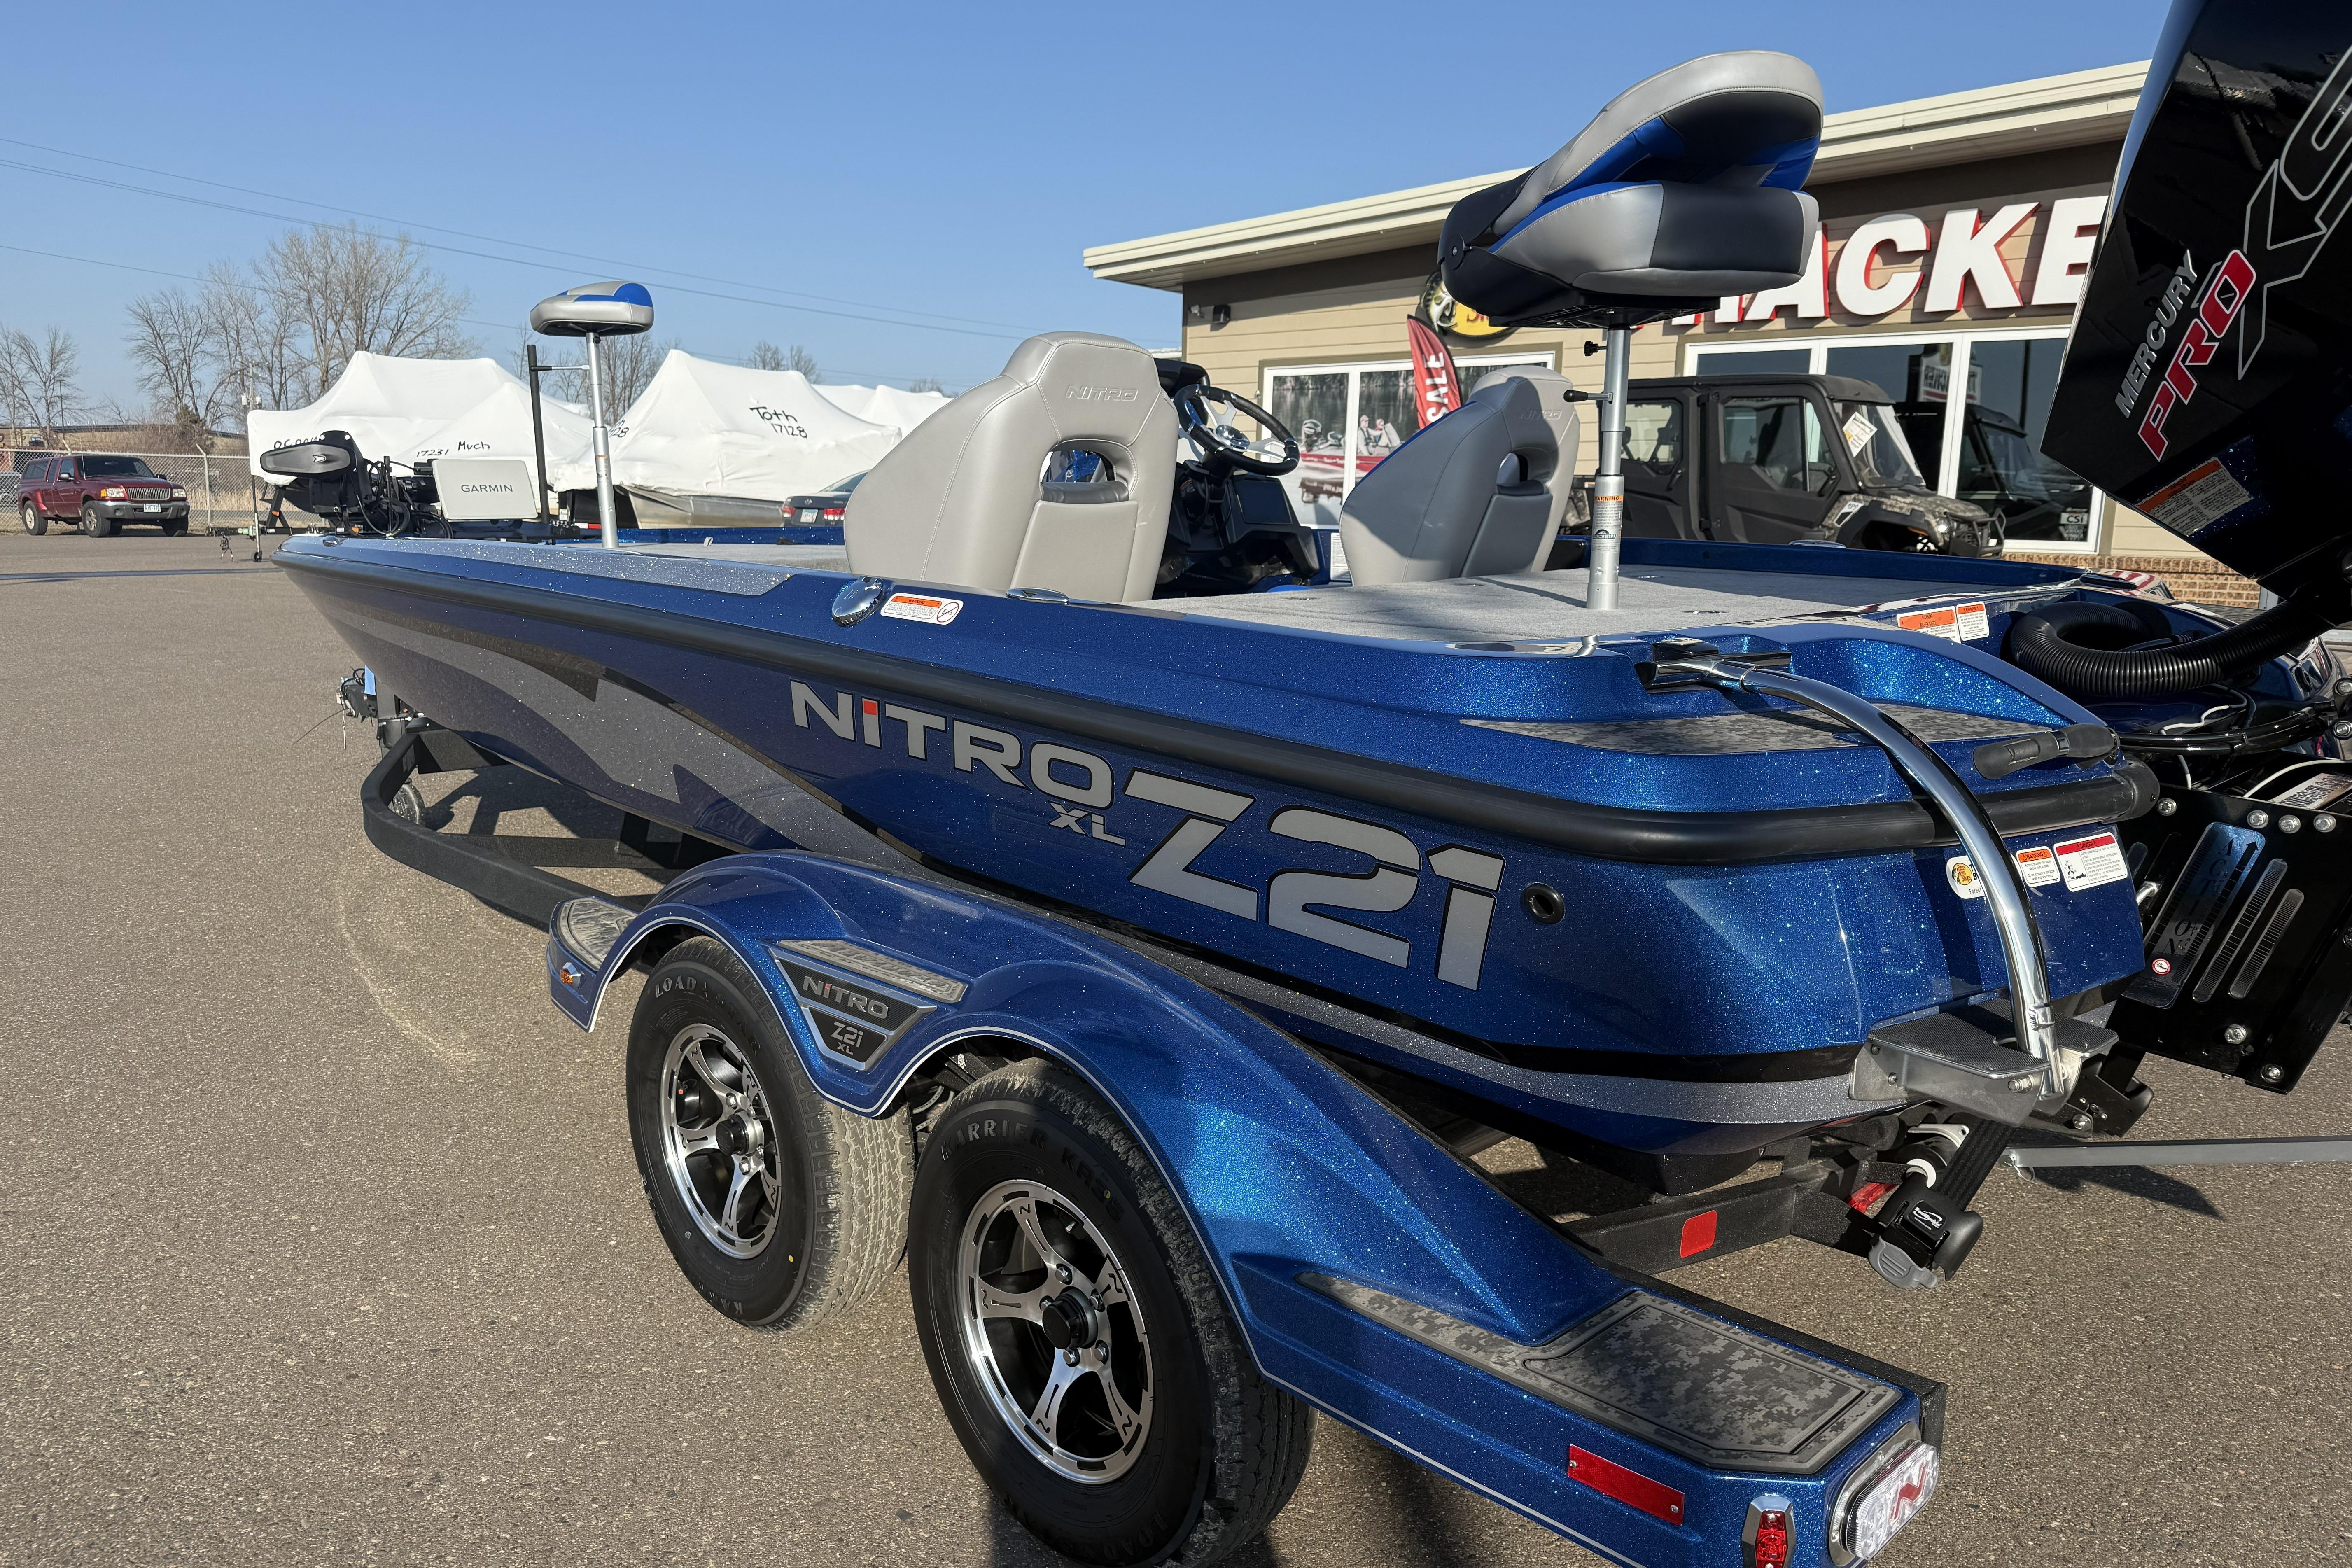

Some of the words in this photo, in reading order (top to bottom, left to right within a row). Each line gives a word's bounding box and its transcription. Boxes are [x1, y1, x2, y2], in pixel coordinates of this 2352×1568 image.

[2115, 249, 2198, 419] MERCURY
[2138, 249, 2256, 462] PRO
[1065, 386, 1138, 401] NITRO
[1423, 352, 1451, 423] SALE
[749, 406, 798, 422] Toth
[771, 423, 807, 438] 17128
[416, 448, 449, 457] 17231
[458, 441, 490, 451] Much
[789, 678, 1115, 809] NITRO
[1047, 800, 1127, 846] XL
[1122, 767, 1506, 992] Z21
[655, 975, 697, 999] LOAD
[803, 976, 889, 1019] NITRO
[836, 1042, 854, 1055] XL
[941, 1119, 1048, 1161] KARRIER
